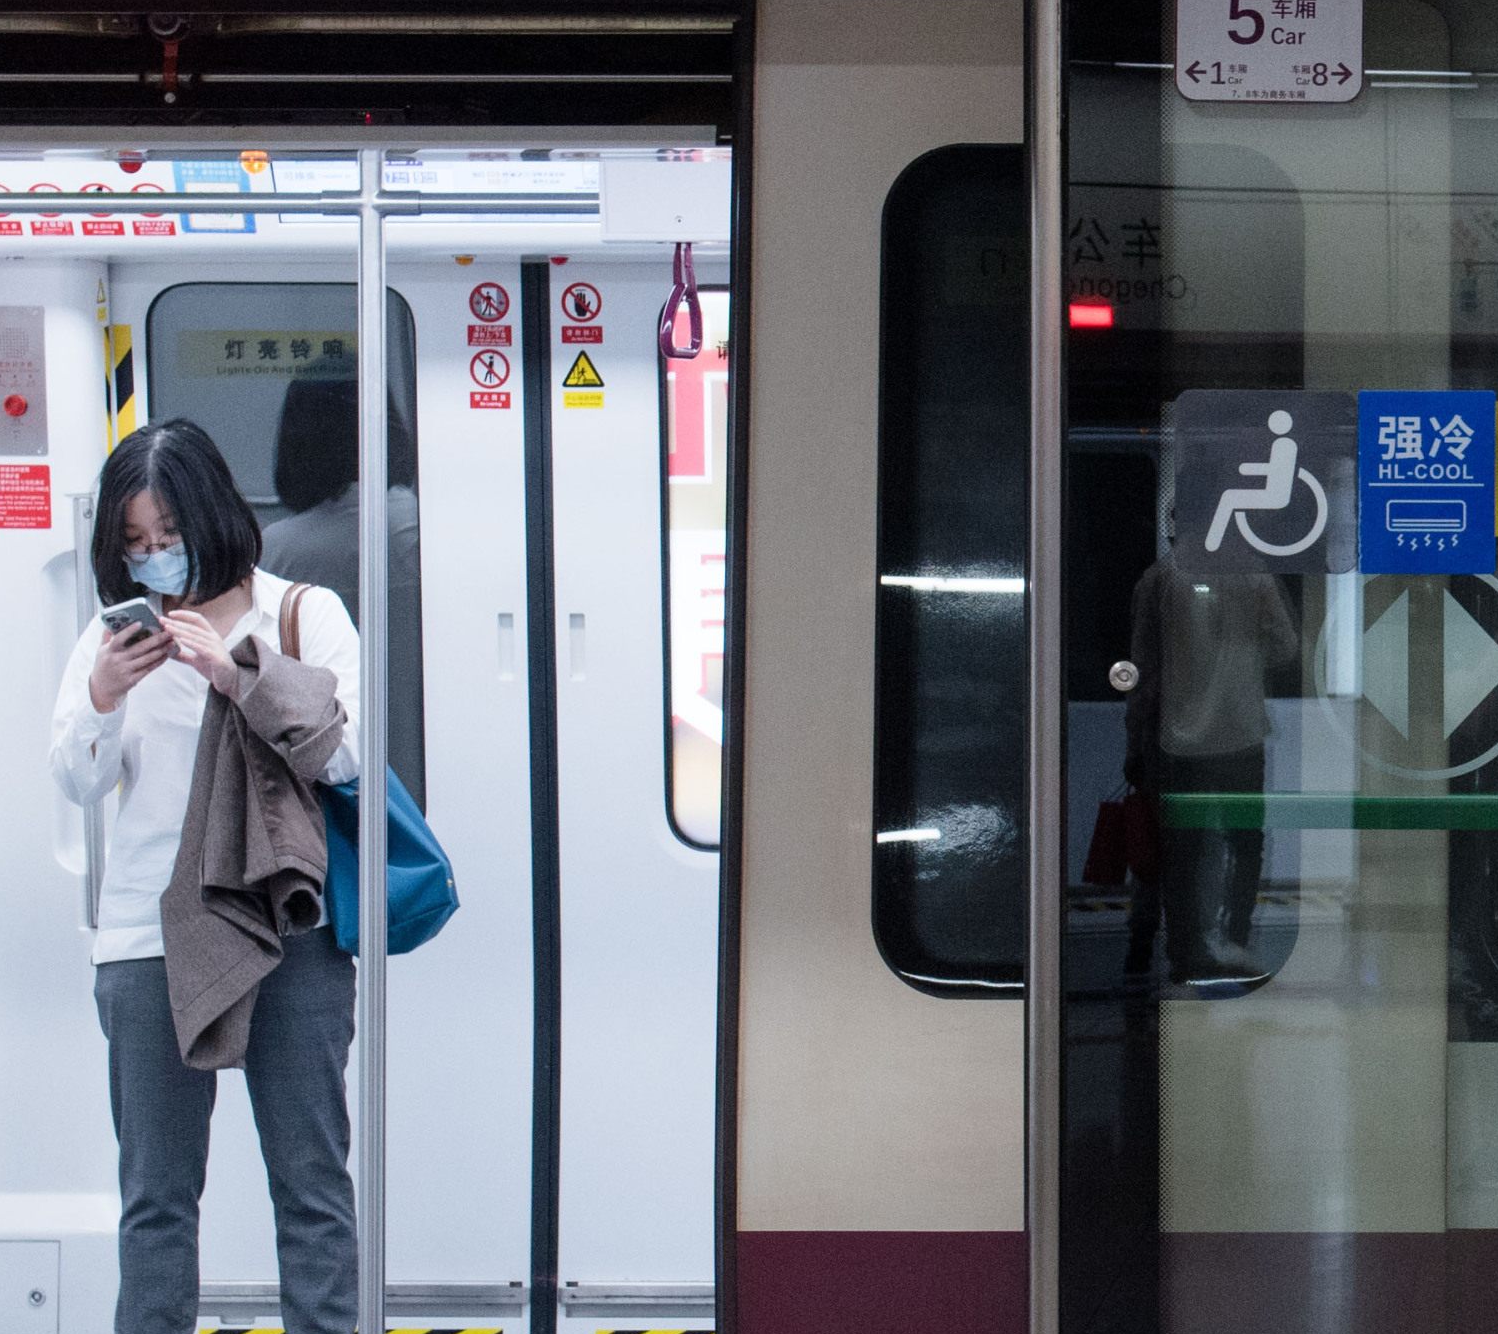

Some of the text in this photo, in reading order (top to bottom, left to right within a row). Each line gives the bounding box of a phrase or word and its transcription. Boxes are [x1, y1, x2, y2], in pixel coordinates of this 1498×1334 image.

[1271, 27, 1306, 45] Car
[1210, 61, 1226, 85] 1
[1228, 76, 1243, 85] Car
[1312, 62, 1329, 86] 8
[1378, 414, 1476, 462] 强冷
[1378, 463, 1475, 481] HL-COOL
